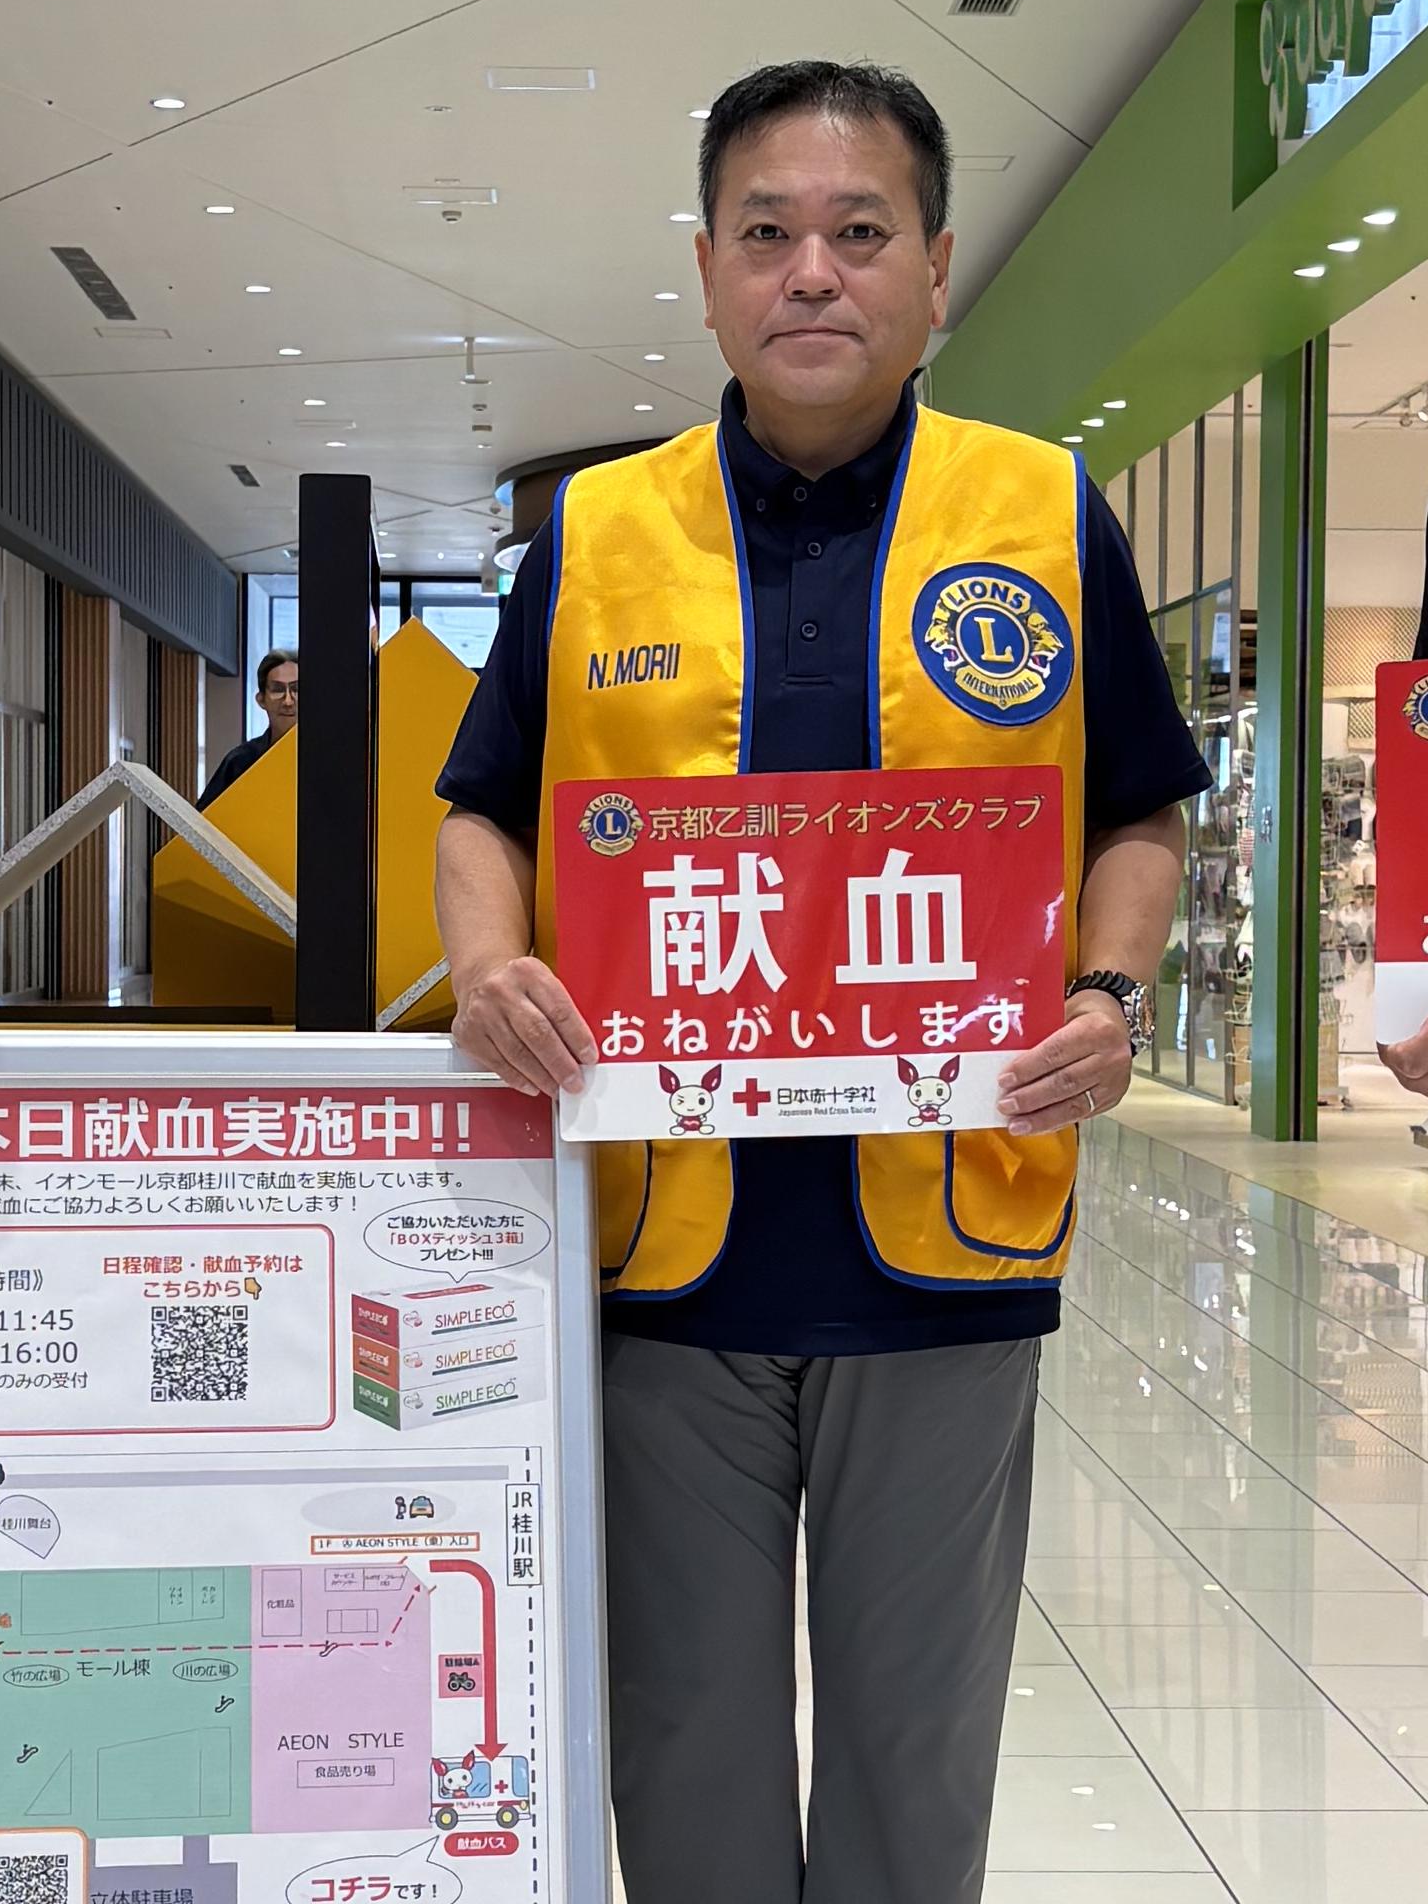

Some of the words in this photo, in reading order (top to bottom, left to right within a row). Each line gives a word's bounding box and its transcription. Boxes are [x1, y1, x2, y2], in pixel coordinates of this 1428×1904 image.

[950, 580, 1026, 615] LIONS
[972, 616, 1015, 664] L
[587, 642, 682, 691] N.MORII
[963, 672, 1039, 700] INTERNATIONAL
[604, 812, 623, 835] L
[647, 794, 1045, 842] 京都乙訓ライオンズクラブ
[642, 846, 977, 997] 献血
[601, 997, 1025, 1058] おねがいします
[777, 1085, 876, 1105] 日本赤十字社
[387, 1215, 525, 1229] ご協力いただいた方に
[102, 1255, 304, 1276] 日程確認・献血予約は
[143, 1279, 241, 1299] こちらから
[435, 1308, 482, 1329] SIMPLE
[435, 1347, 482, 1369] SIMPLE
[436, 1387, 484, 1410] SIMPLE
[355, 1537, 385, 1548] AEON
[387, 1536, 419, 1548] STYLE
[76, 1660, 151, 1678] モール棟
[277, 1733, 330, 1751] AEON
[347, 1732, 405, 1749] STYLE
